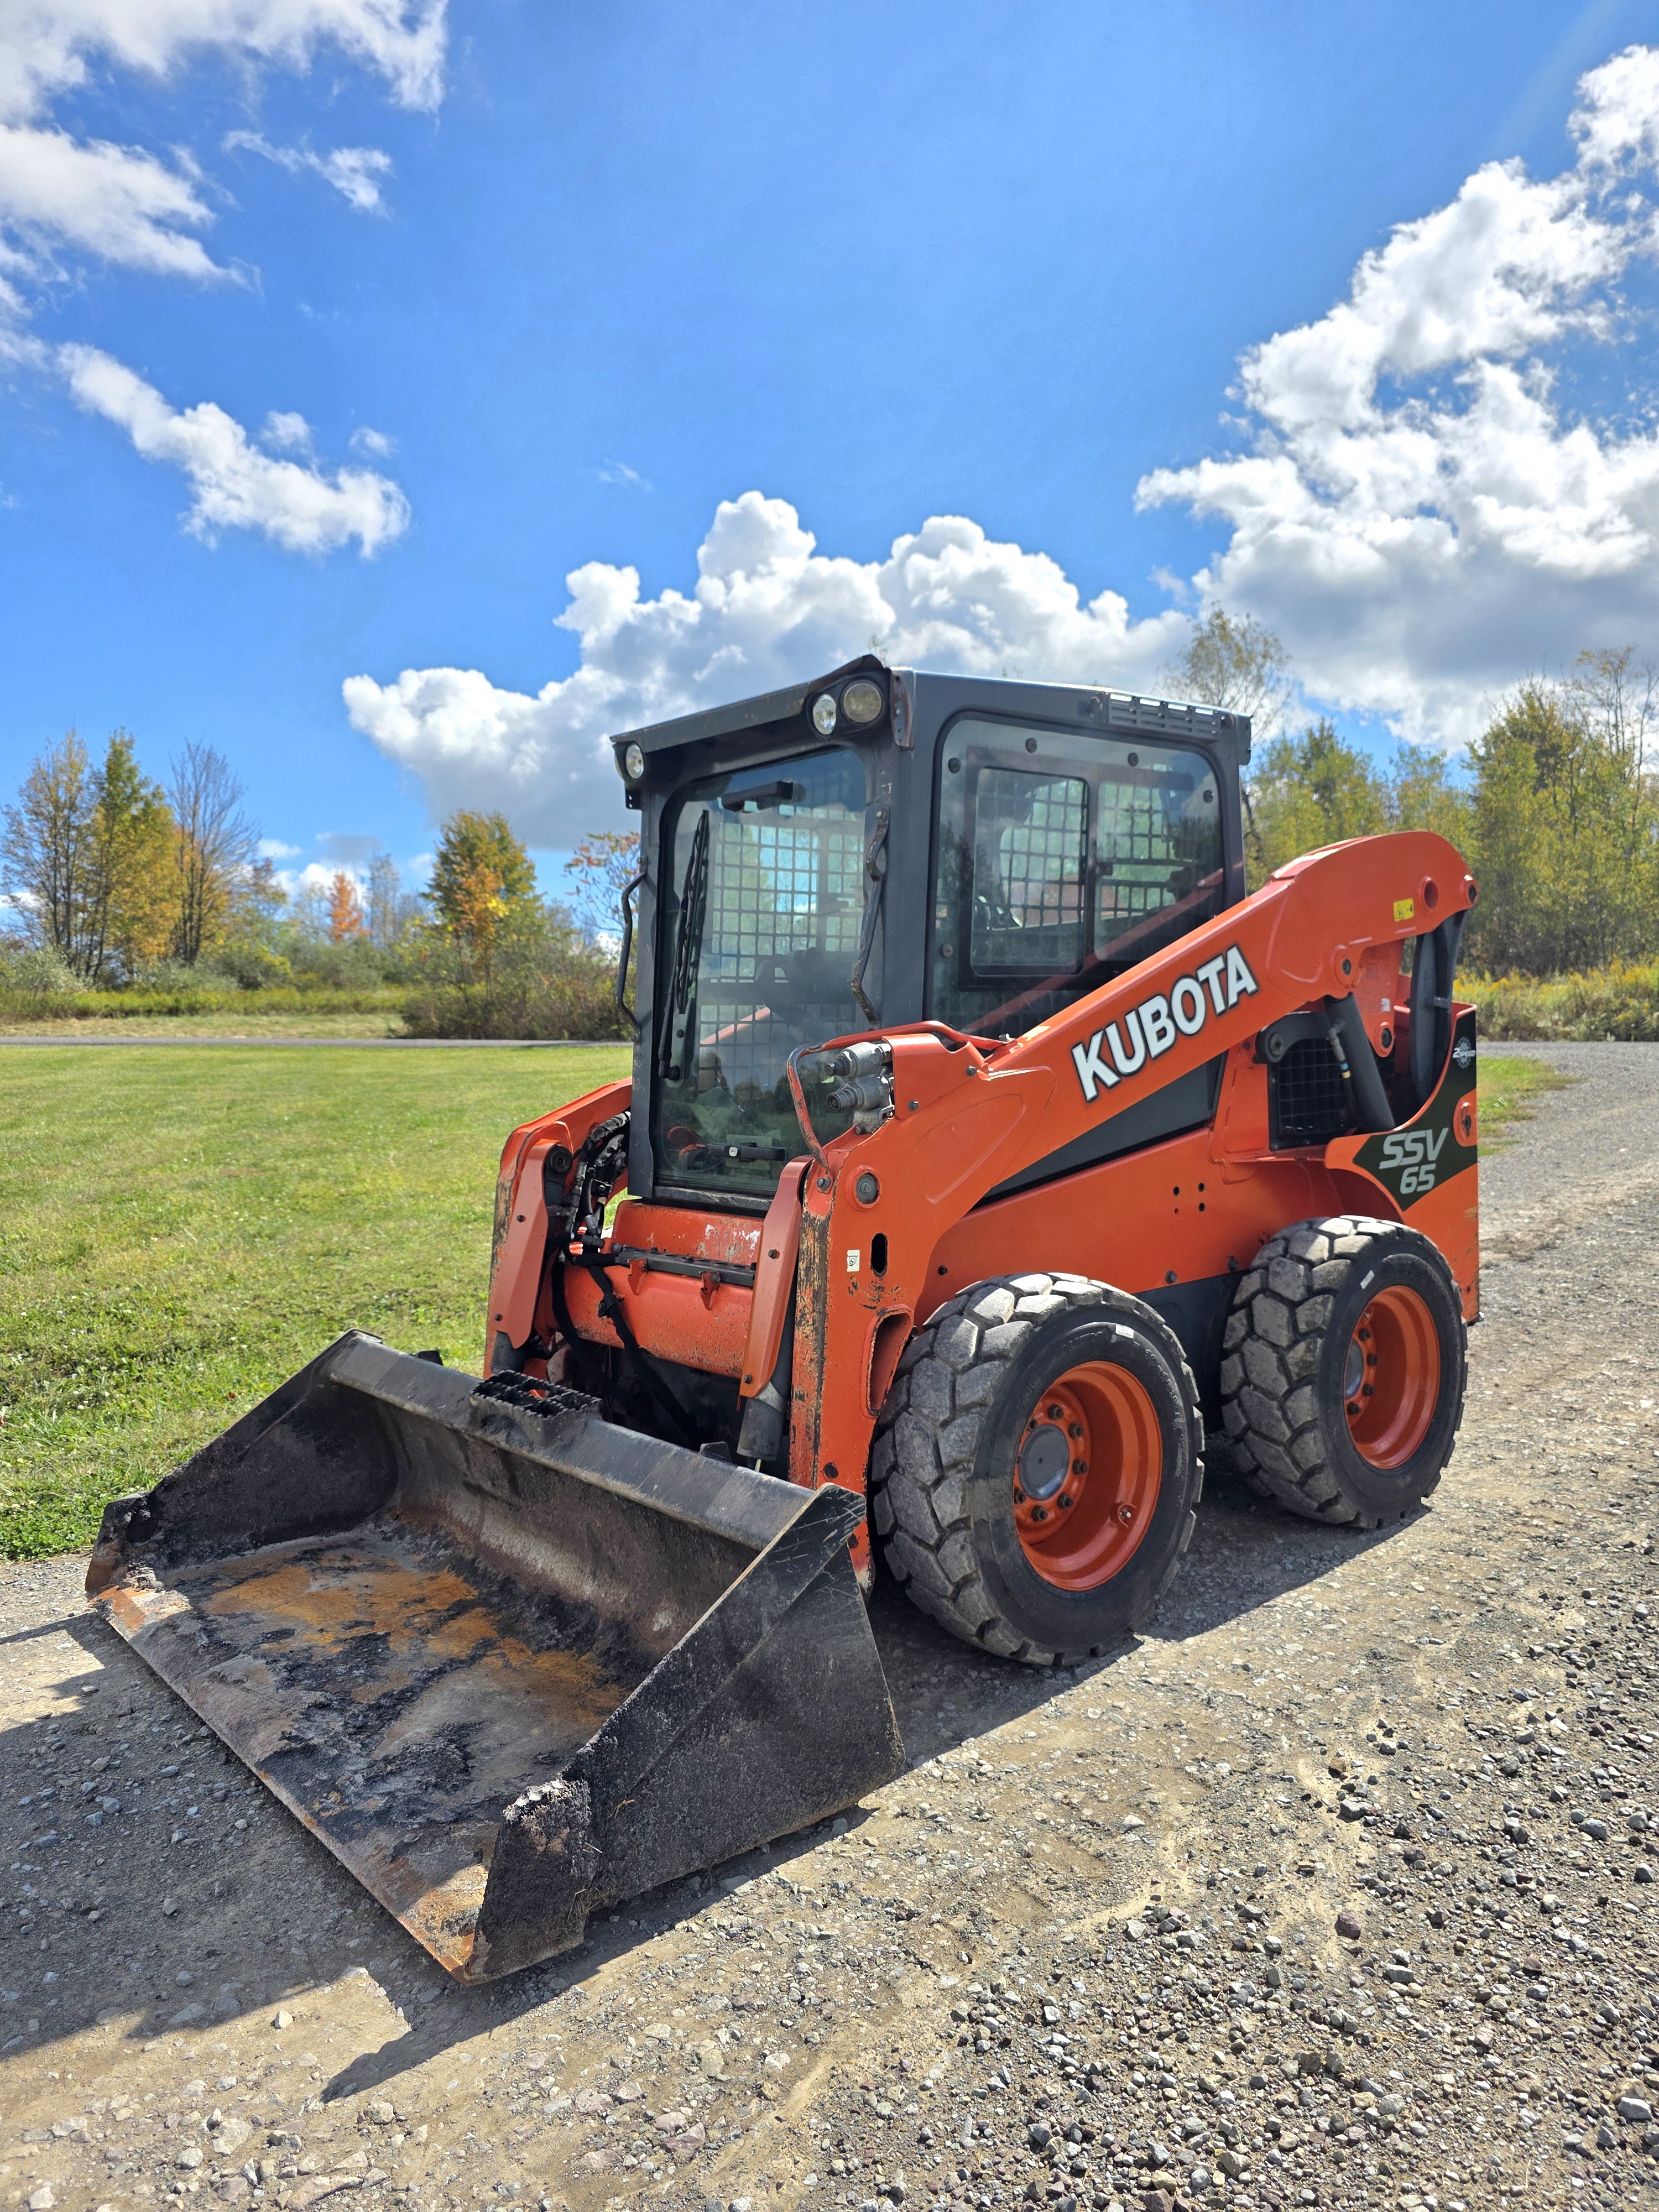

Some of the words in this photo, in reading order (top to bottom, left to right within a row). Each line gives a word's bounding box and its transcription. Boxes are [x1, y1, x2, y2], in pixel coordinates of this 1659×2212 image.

[1071, 945, 1259, 1102] KUBOTA
[1379, 1127, 1449, 1170] SSV
[1400, 1163, 1436, 1194] 65
